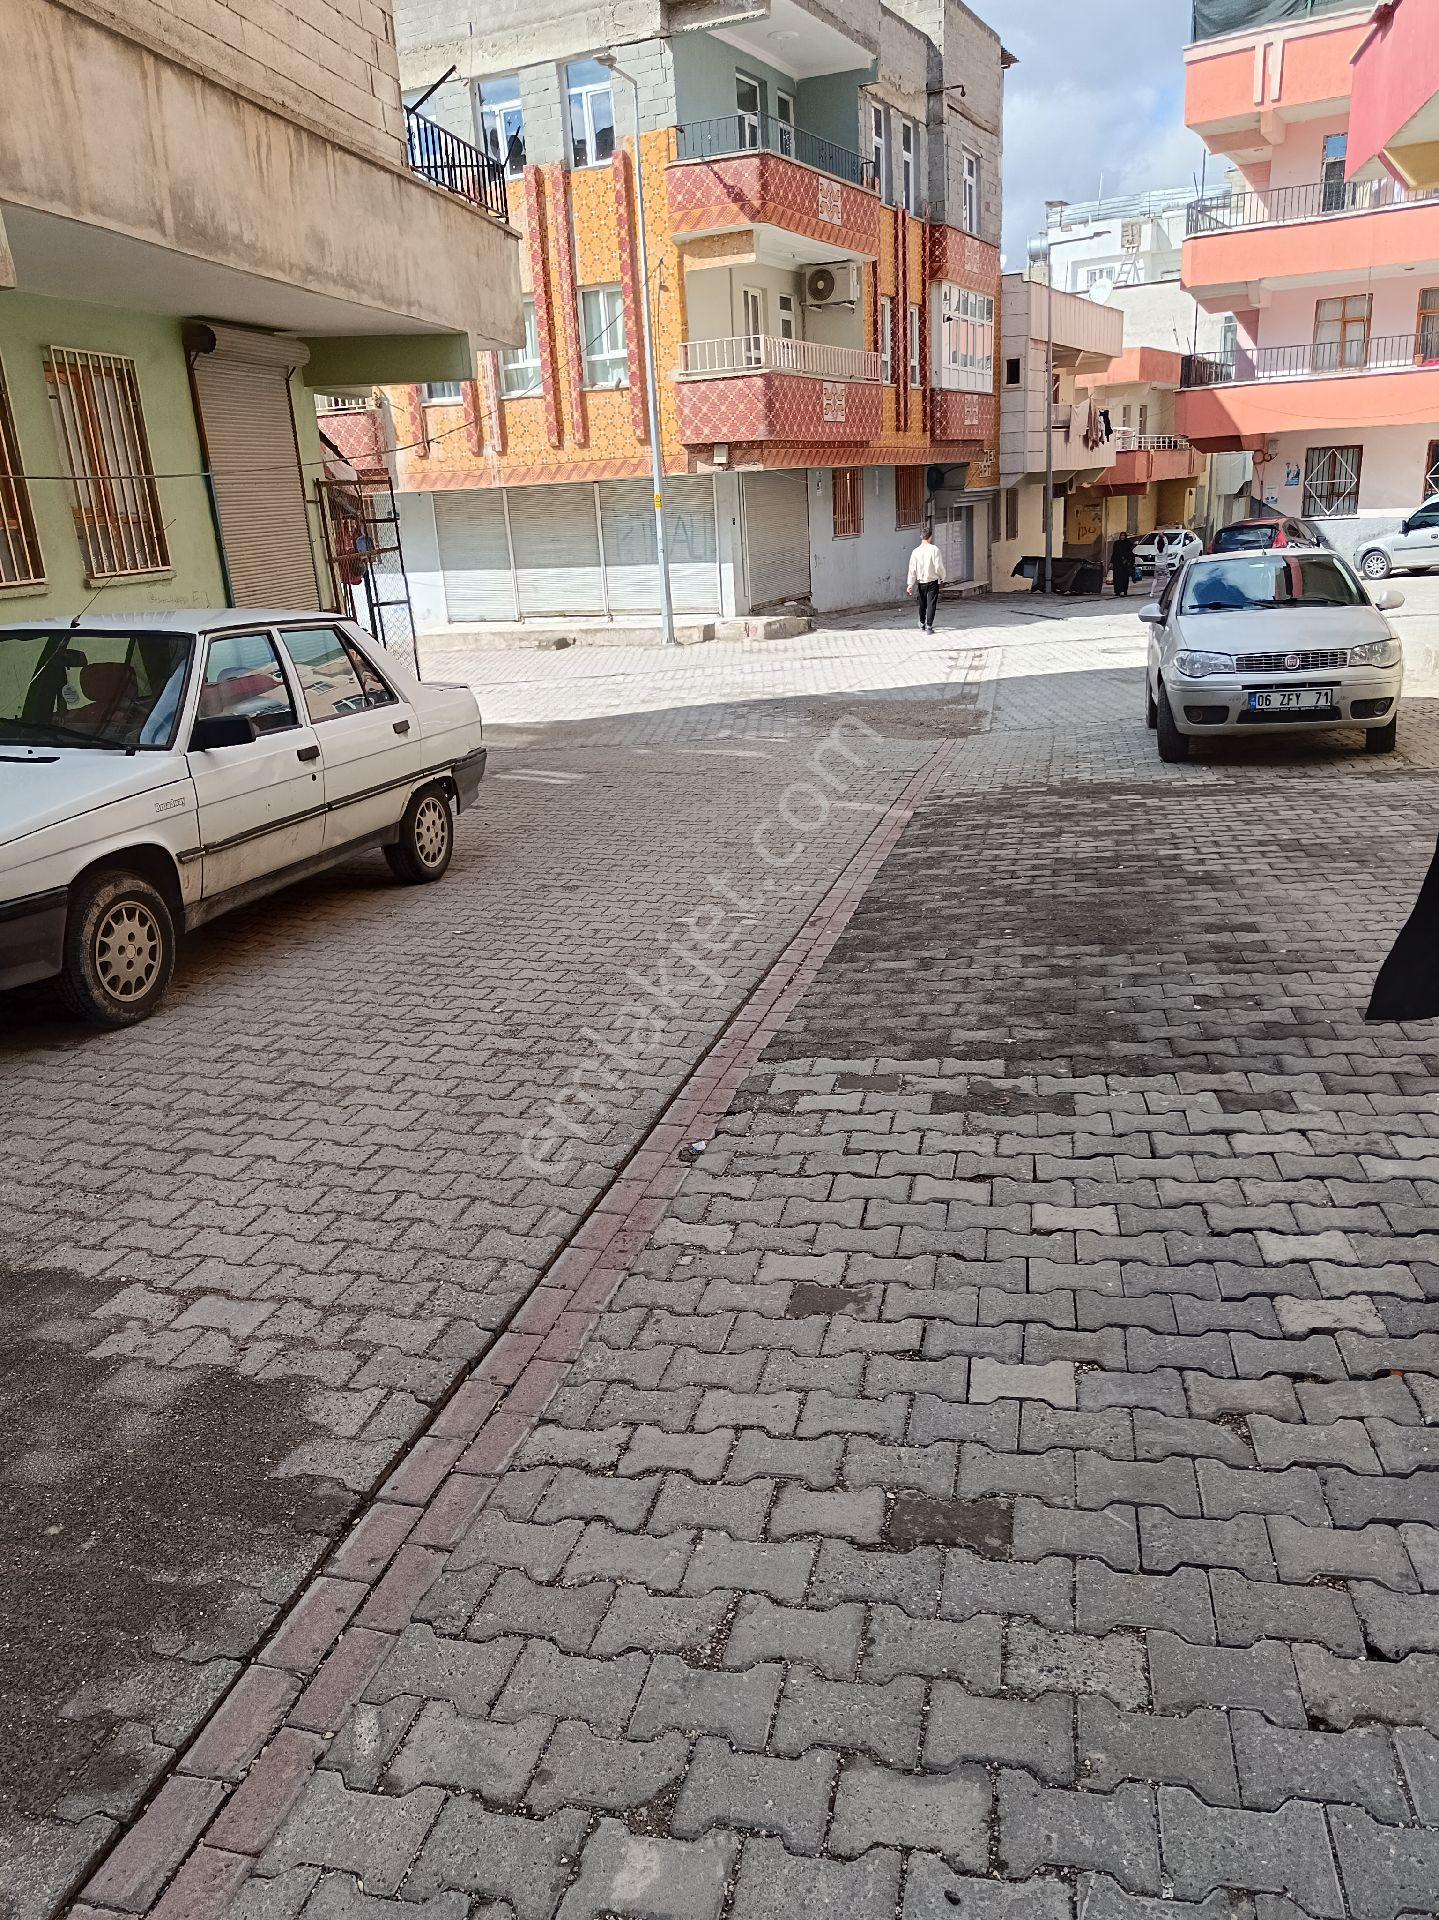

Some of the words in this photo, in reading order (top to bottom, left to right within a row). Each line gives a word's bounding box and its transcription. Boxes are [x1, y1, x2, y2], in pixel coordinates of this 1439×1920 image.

[1257, 694, 1271, 706] 06
[1280, 693, 1301, 706] ZFY
[1315, 692, 1329, 705] 71
[154, 797, 185, 812] Broadway
